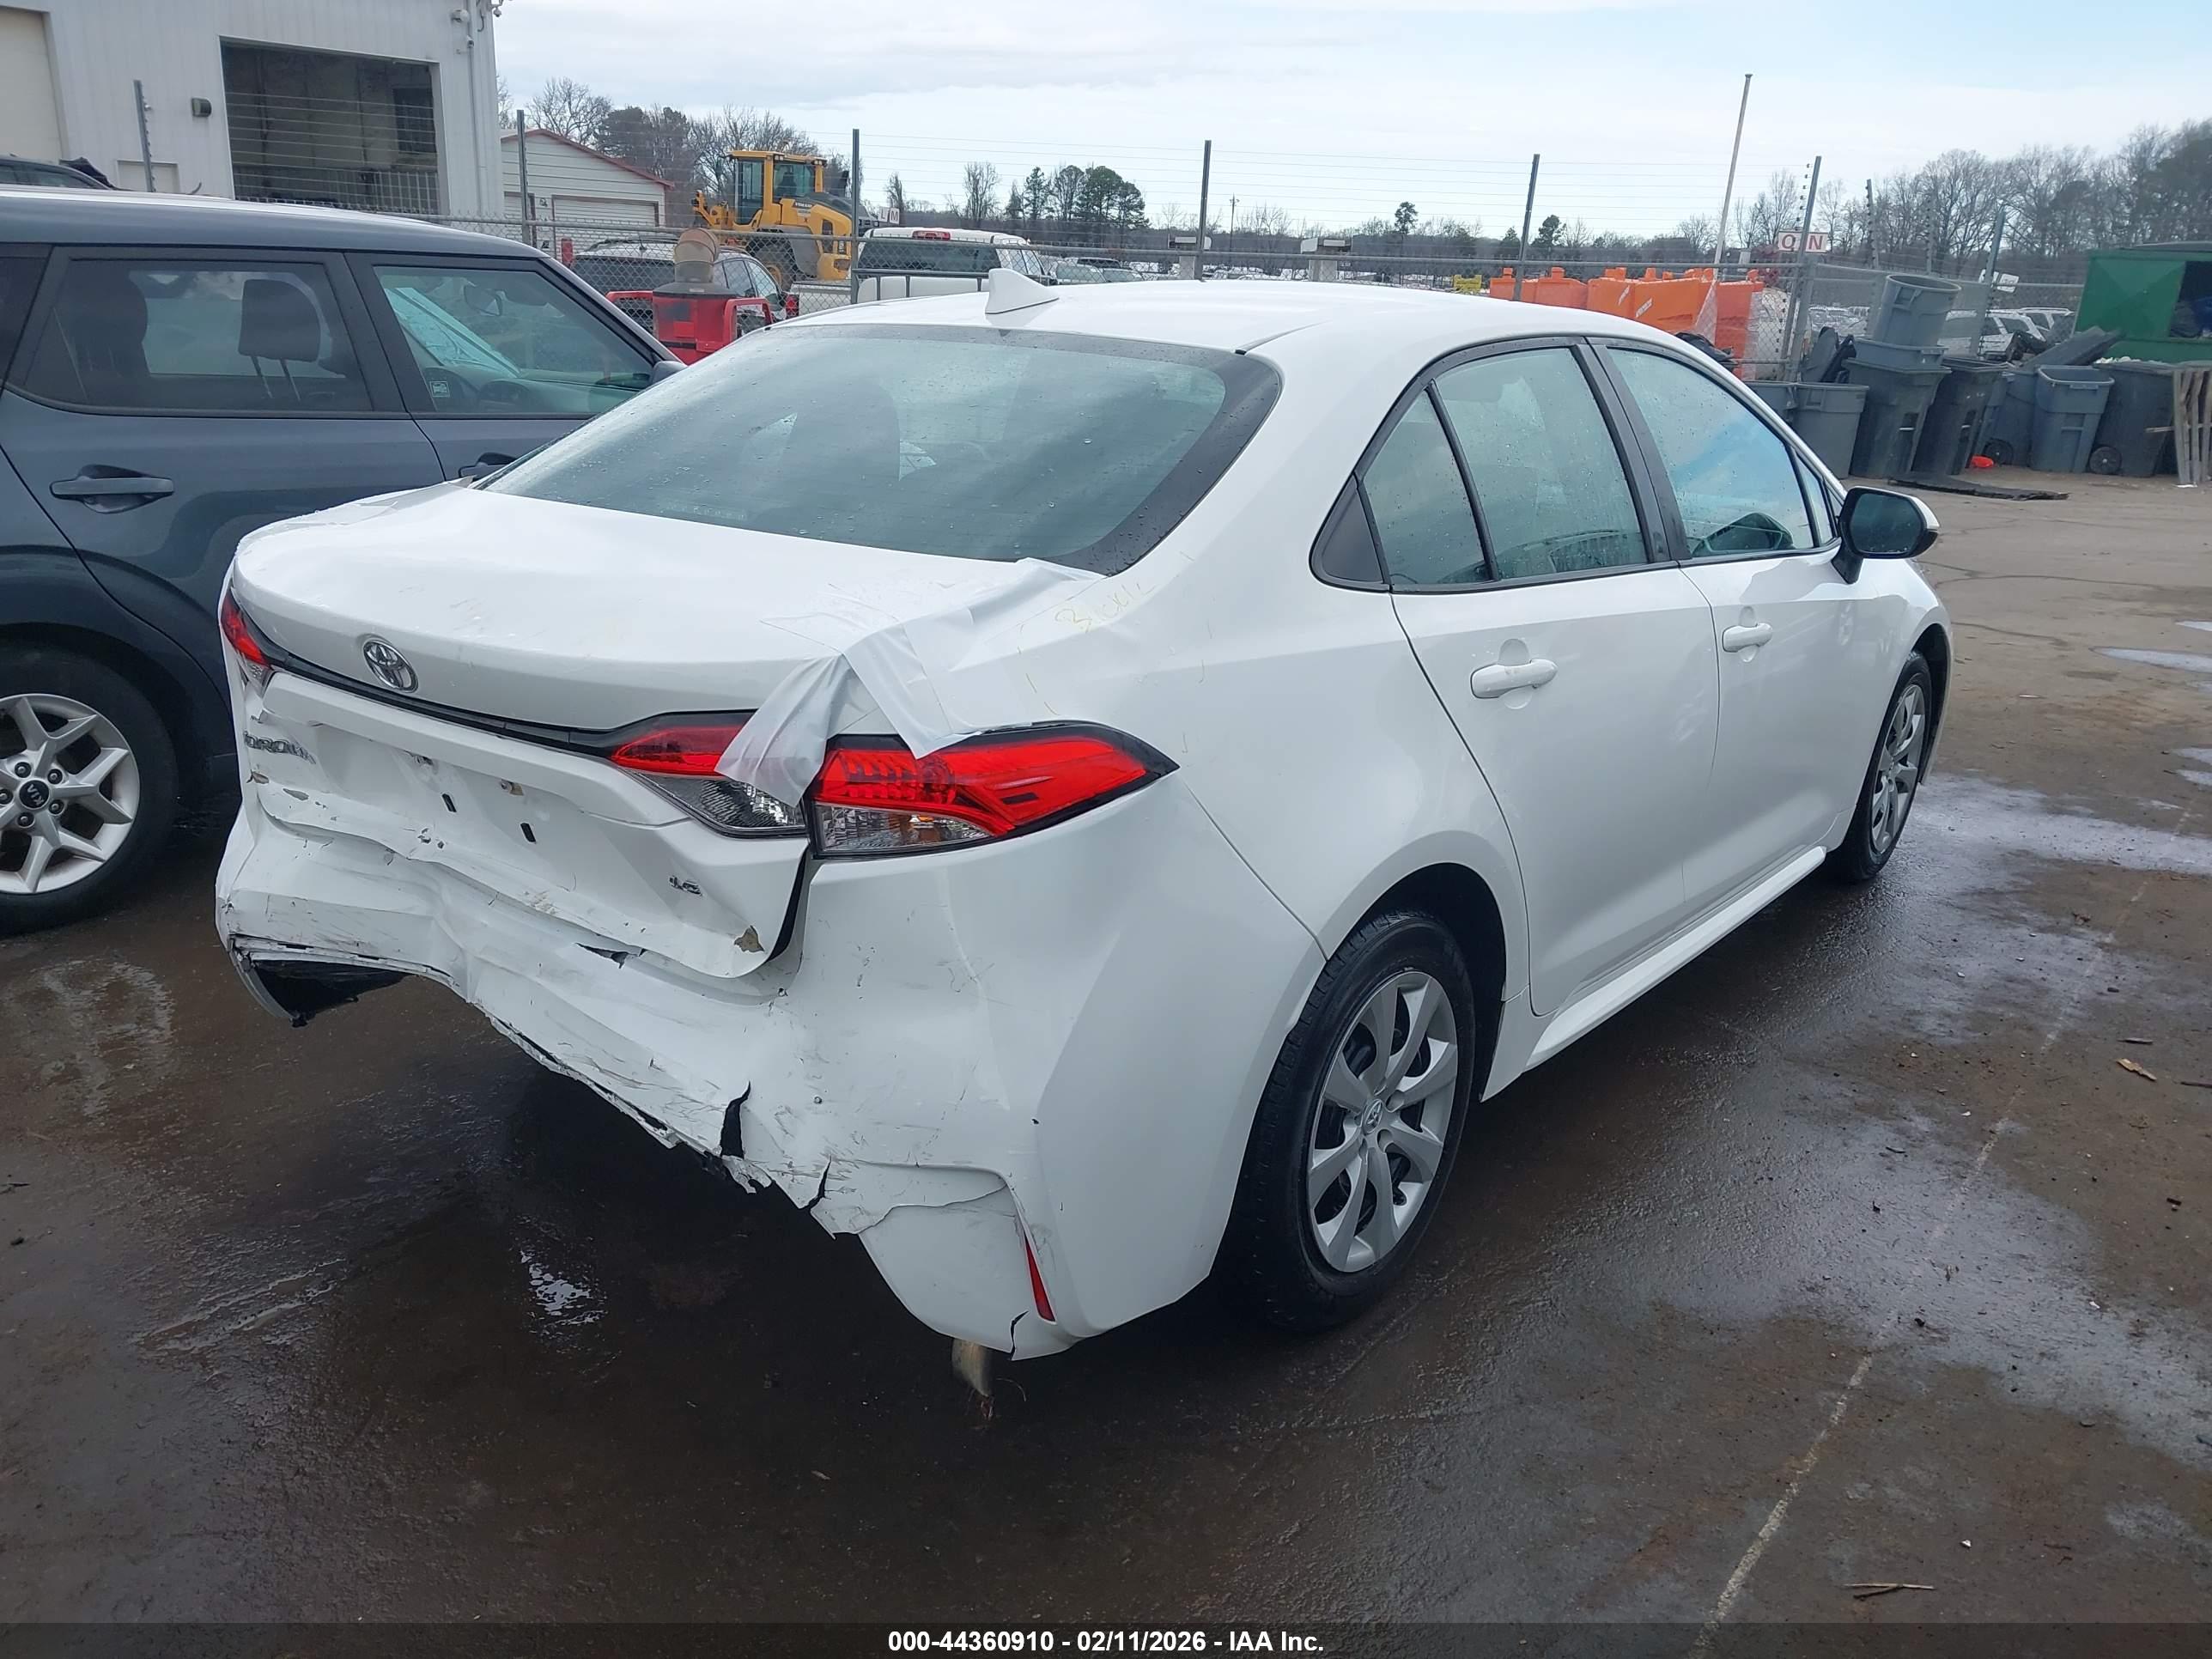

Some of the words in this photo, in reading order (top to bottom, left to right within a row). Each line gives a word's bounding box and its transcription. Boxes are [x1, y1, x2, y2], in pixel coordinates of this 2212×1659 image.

[890, 210, 899, 221] M
[1808, 234, 1823, 250] N
[27, 783, 45, 806] KIA
